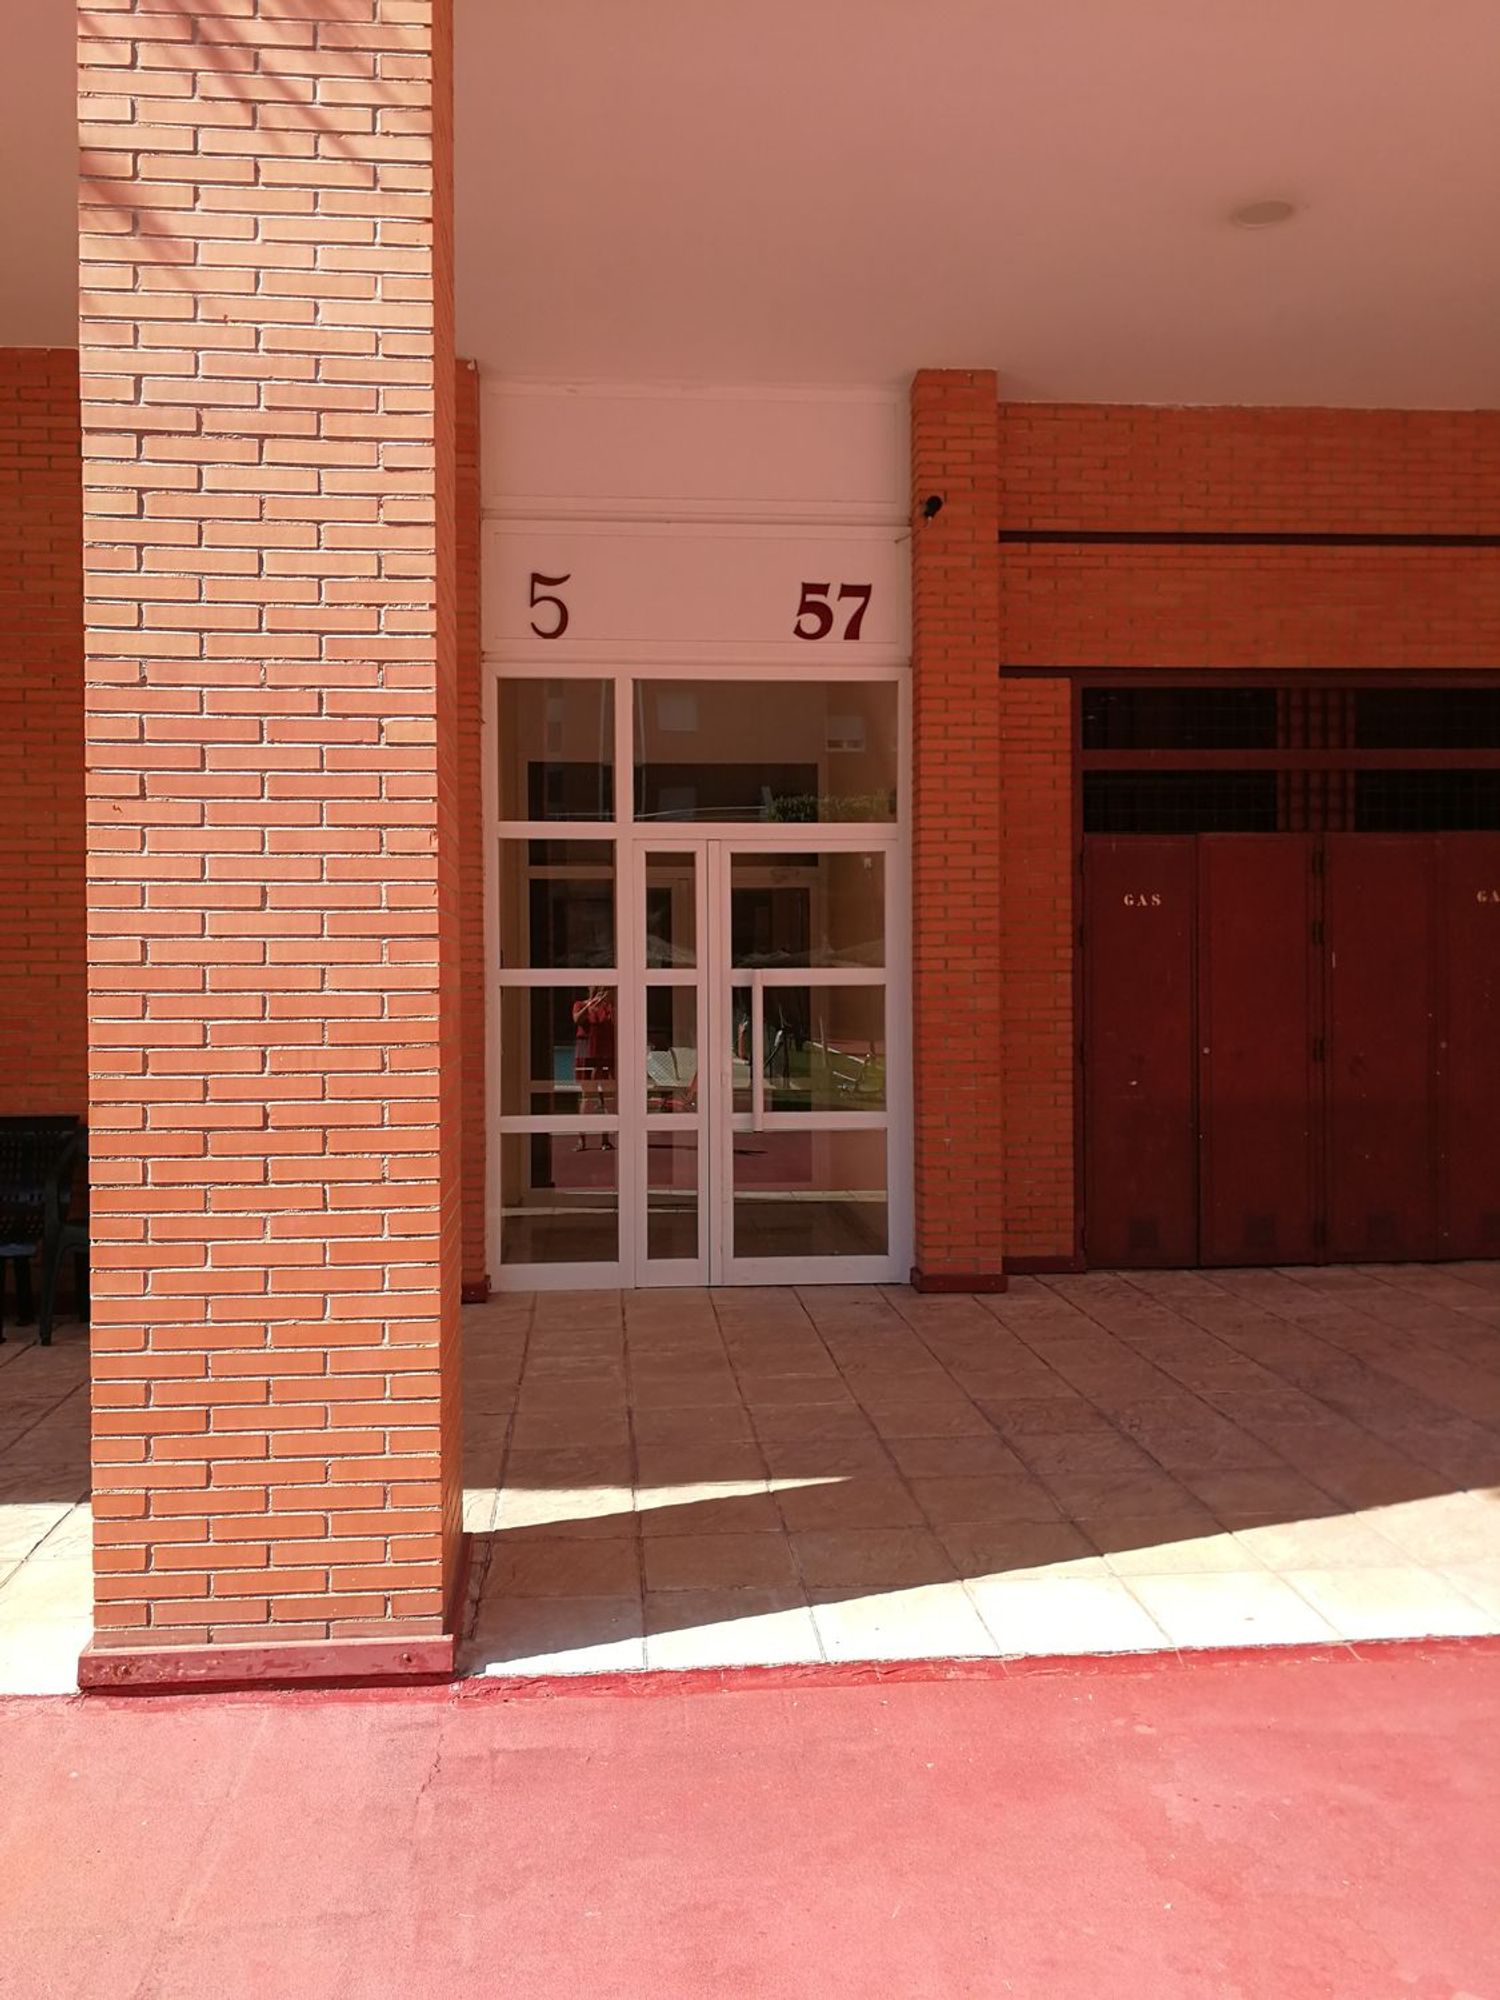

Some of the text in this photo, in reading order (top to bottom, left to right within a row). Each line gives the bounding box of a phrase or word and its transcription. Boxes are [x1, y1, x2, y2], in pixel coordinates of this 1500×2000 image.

[530, 572, 571, 640] 5
[793, 582, 872, 640] 57
[1123, 893, 1161, 907] GAS
